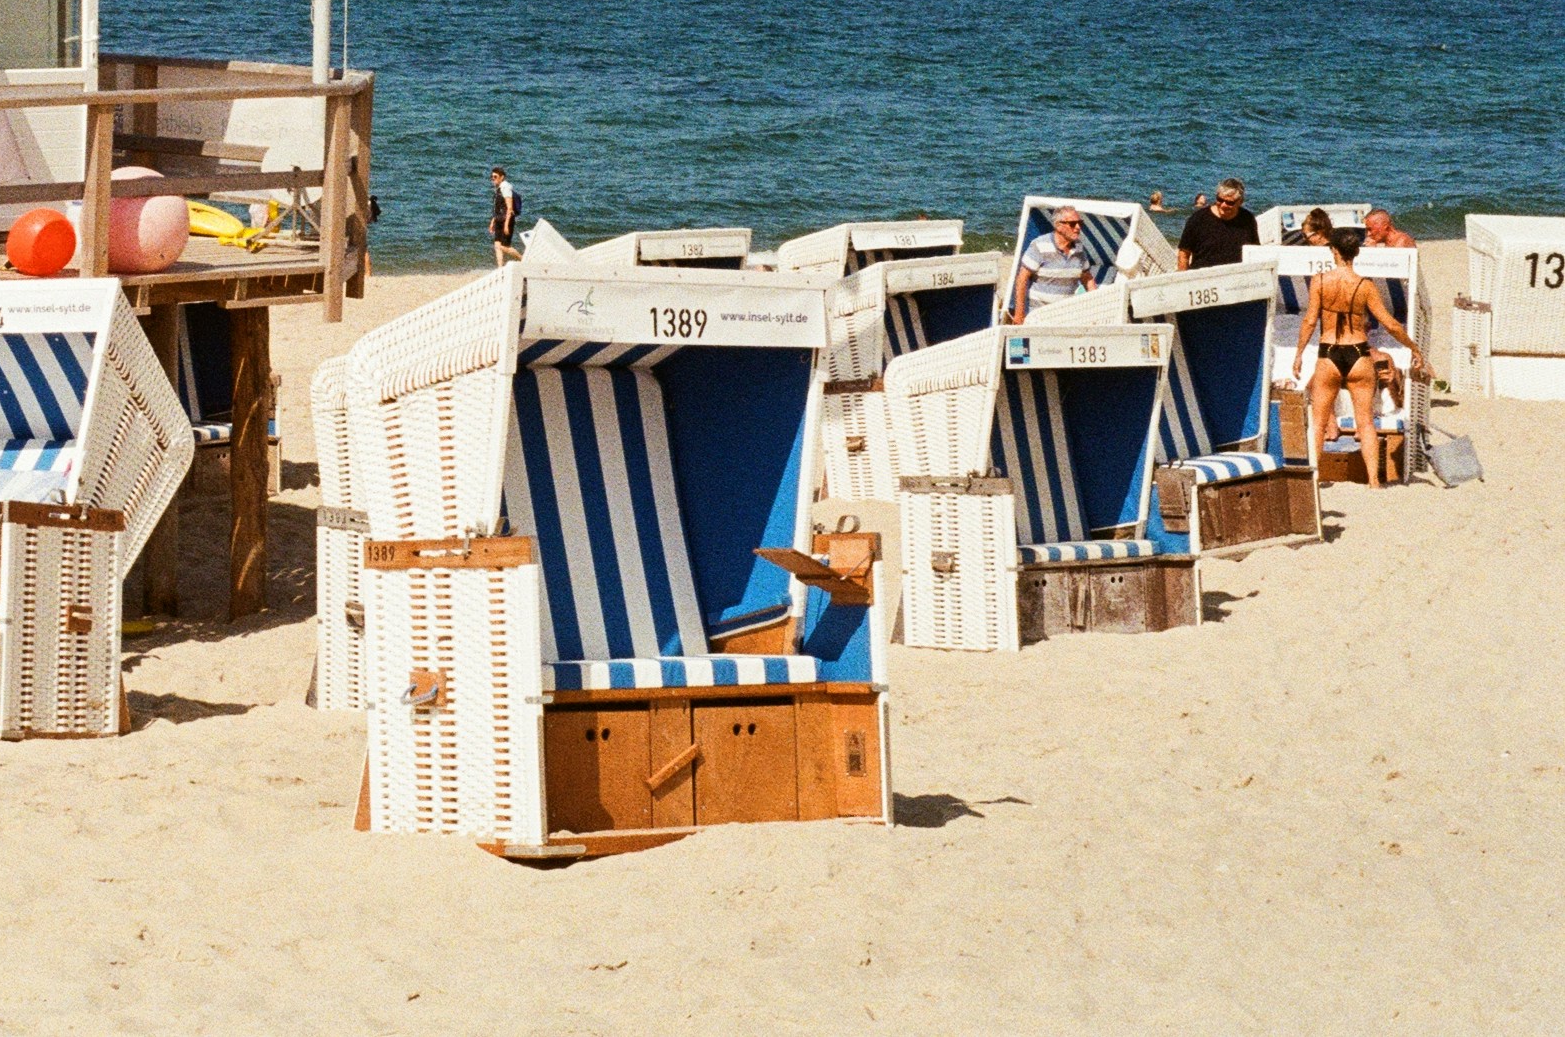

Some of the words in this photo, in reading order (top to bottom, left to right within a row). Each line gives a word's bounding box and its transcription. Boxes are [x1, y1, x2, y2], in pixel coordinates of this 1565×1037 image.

[894, 235, 917, 246] 1381
[682, 244, 704, 256] 1382
[1308, 260, 1333, 274] 135
[932, 272, 955, 287] 1384
[1188, 287, 1219, 306] 1385
[7, 303, 92, 318] www.insel-sylt.de
[649, 307, 708, 338] 1389
[720, 311, 809, 325] www.insel-sylt.de
[1068, 346, 1107, 364] 1383
[367, 545, 396, 562] 1389
